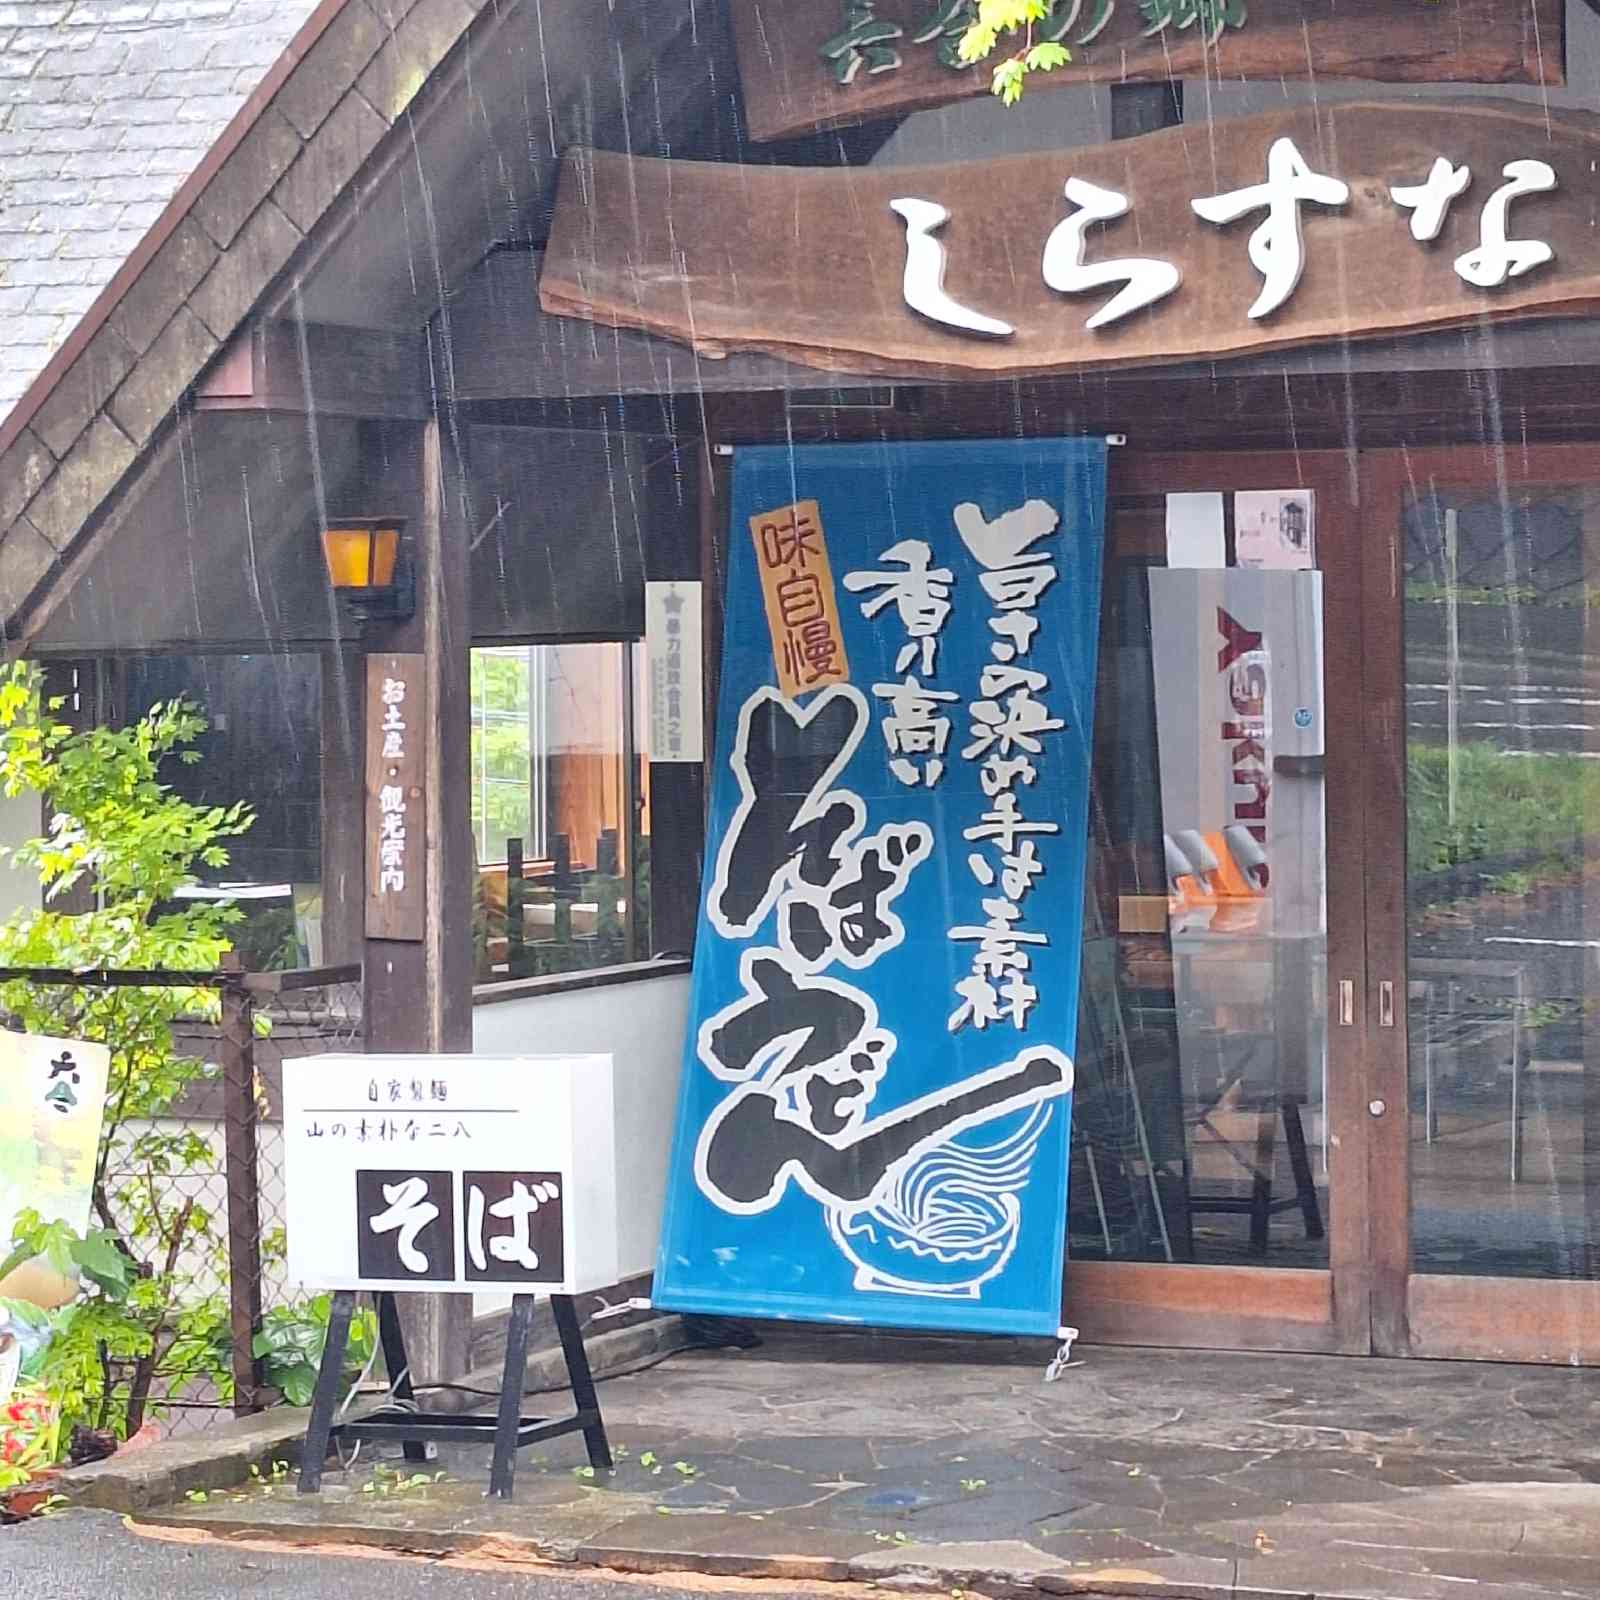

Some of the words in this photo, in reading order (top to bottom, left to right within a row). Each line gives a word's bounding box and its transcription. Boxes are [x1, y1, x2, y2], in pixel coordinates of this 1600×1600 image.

[890, 137, 1556, 337] しらすな
[761, 511, 842, 686] 味自慢
[843, 540, 960, 787] 香り高い
[948, 500, 1064, 1031] 旨さの決め手は素材
[306, 1119, 472, 1142] 山の素朴な二八
[368, 1079, 448, 1102] 自家製麺
[370, 1177, 560, 1273] そば
